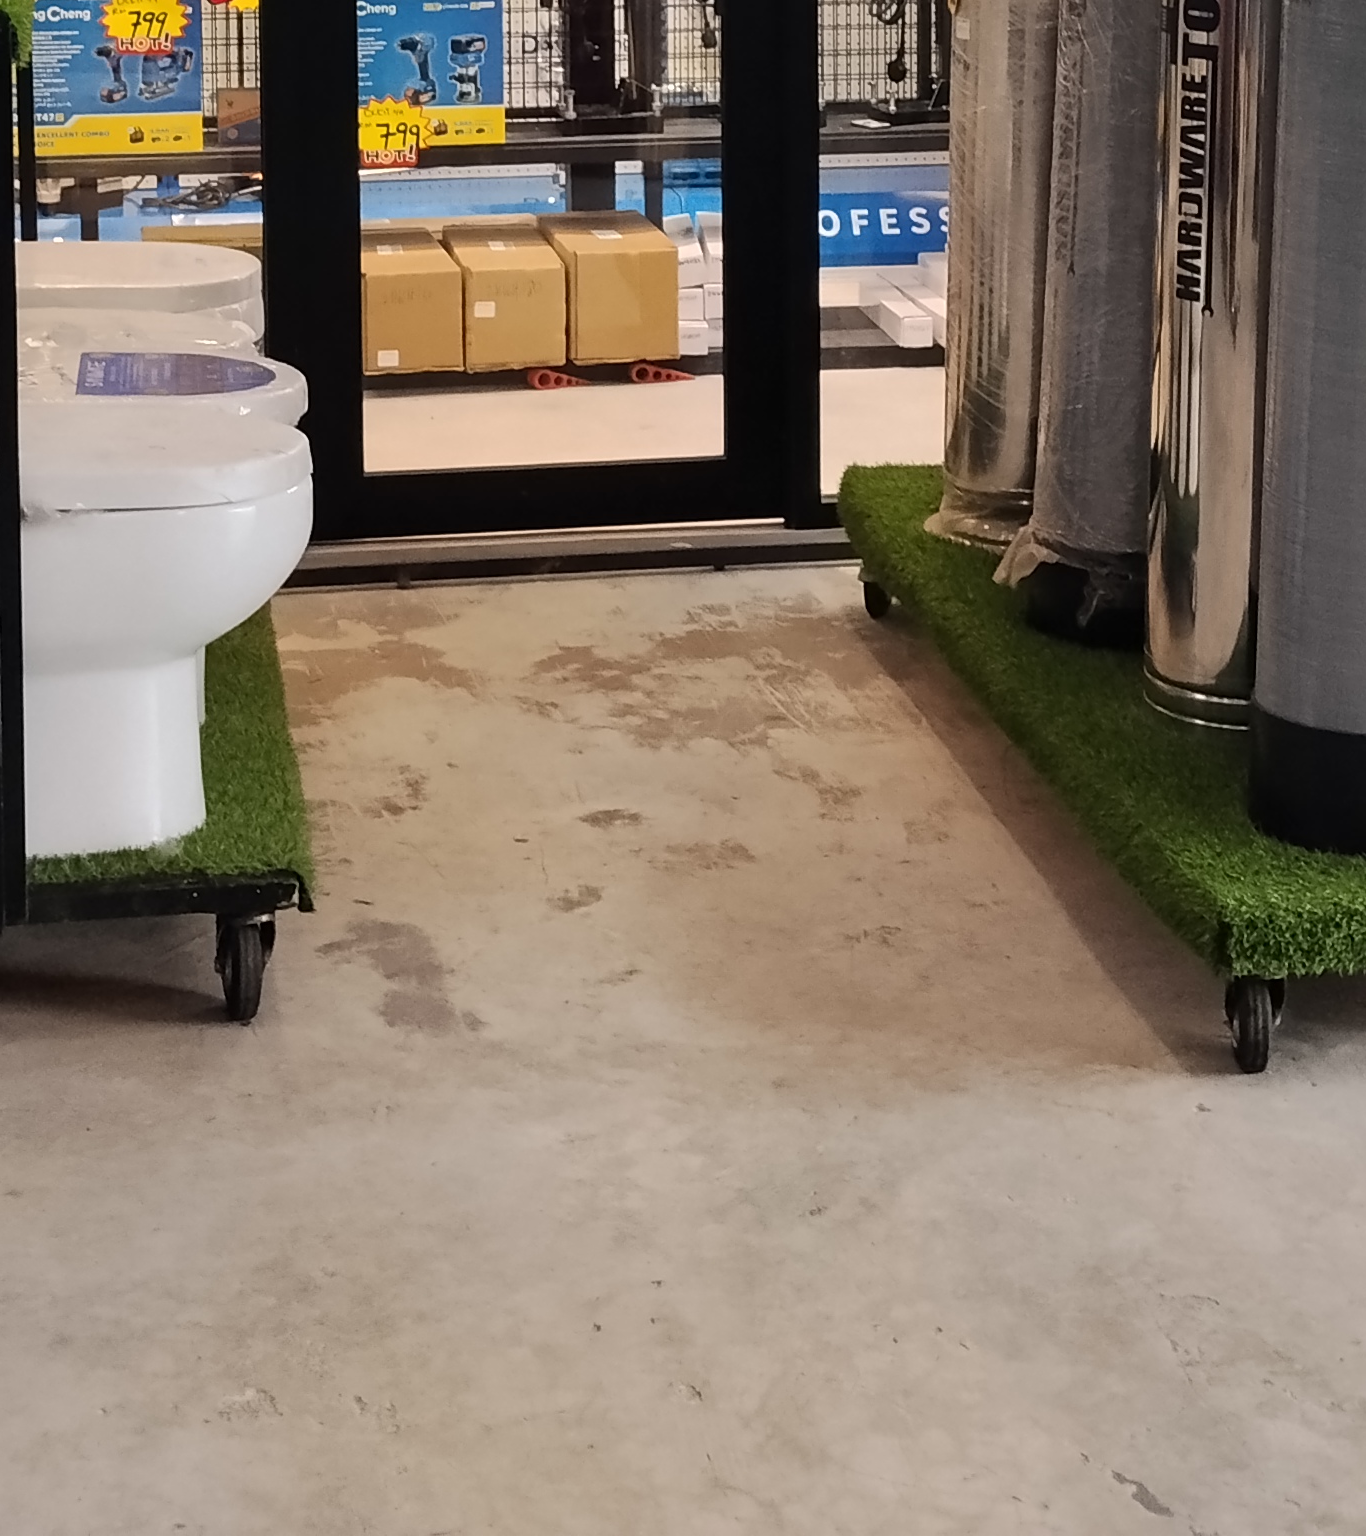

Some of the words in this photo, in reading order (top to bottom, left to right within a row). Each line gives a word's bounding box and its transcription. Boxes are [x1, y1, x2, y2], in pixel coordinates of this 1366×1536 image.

[128, 10, 169, 40] 799
[117, 32, 173, 52] HOT!
[375, 121, 421, 150] 799
[363, 143, 418, 164] HOT!
[1176, 65, 1208, 303] HARDWARE
